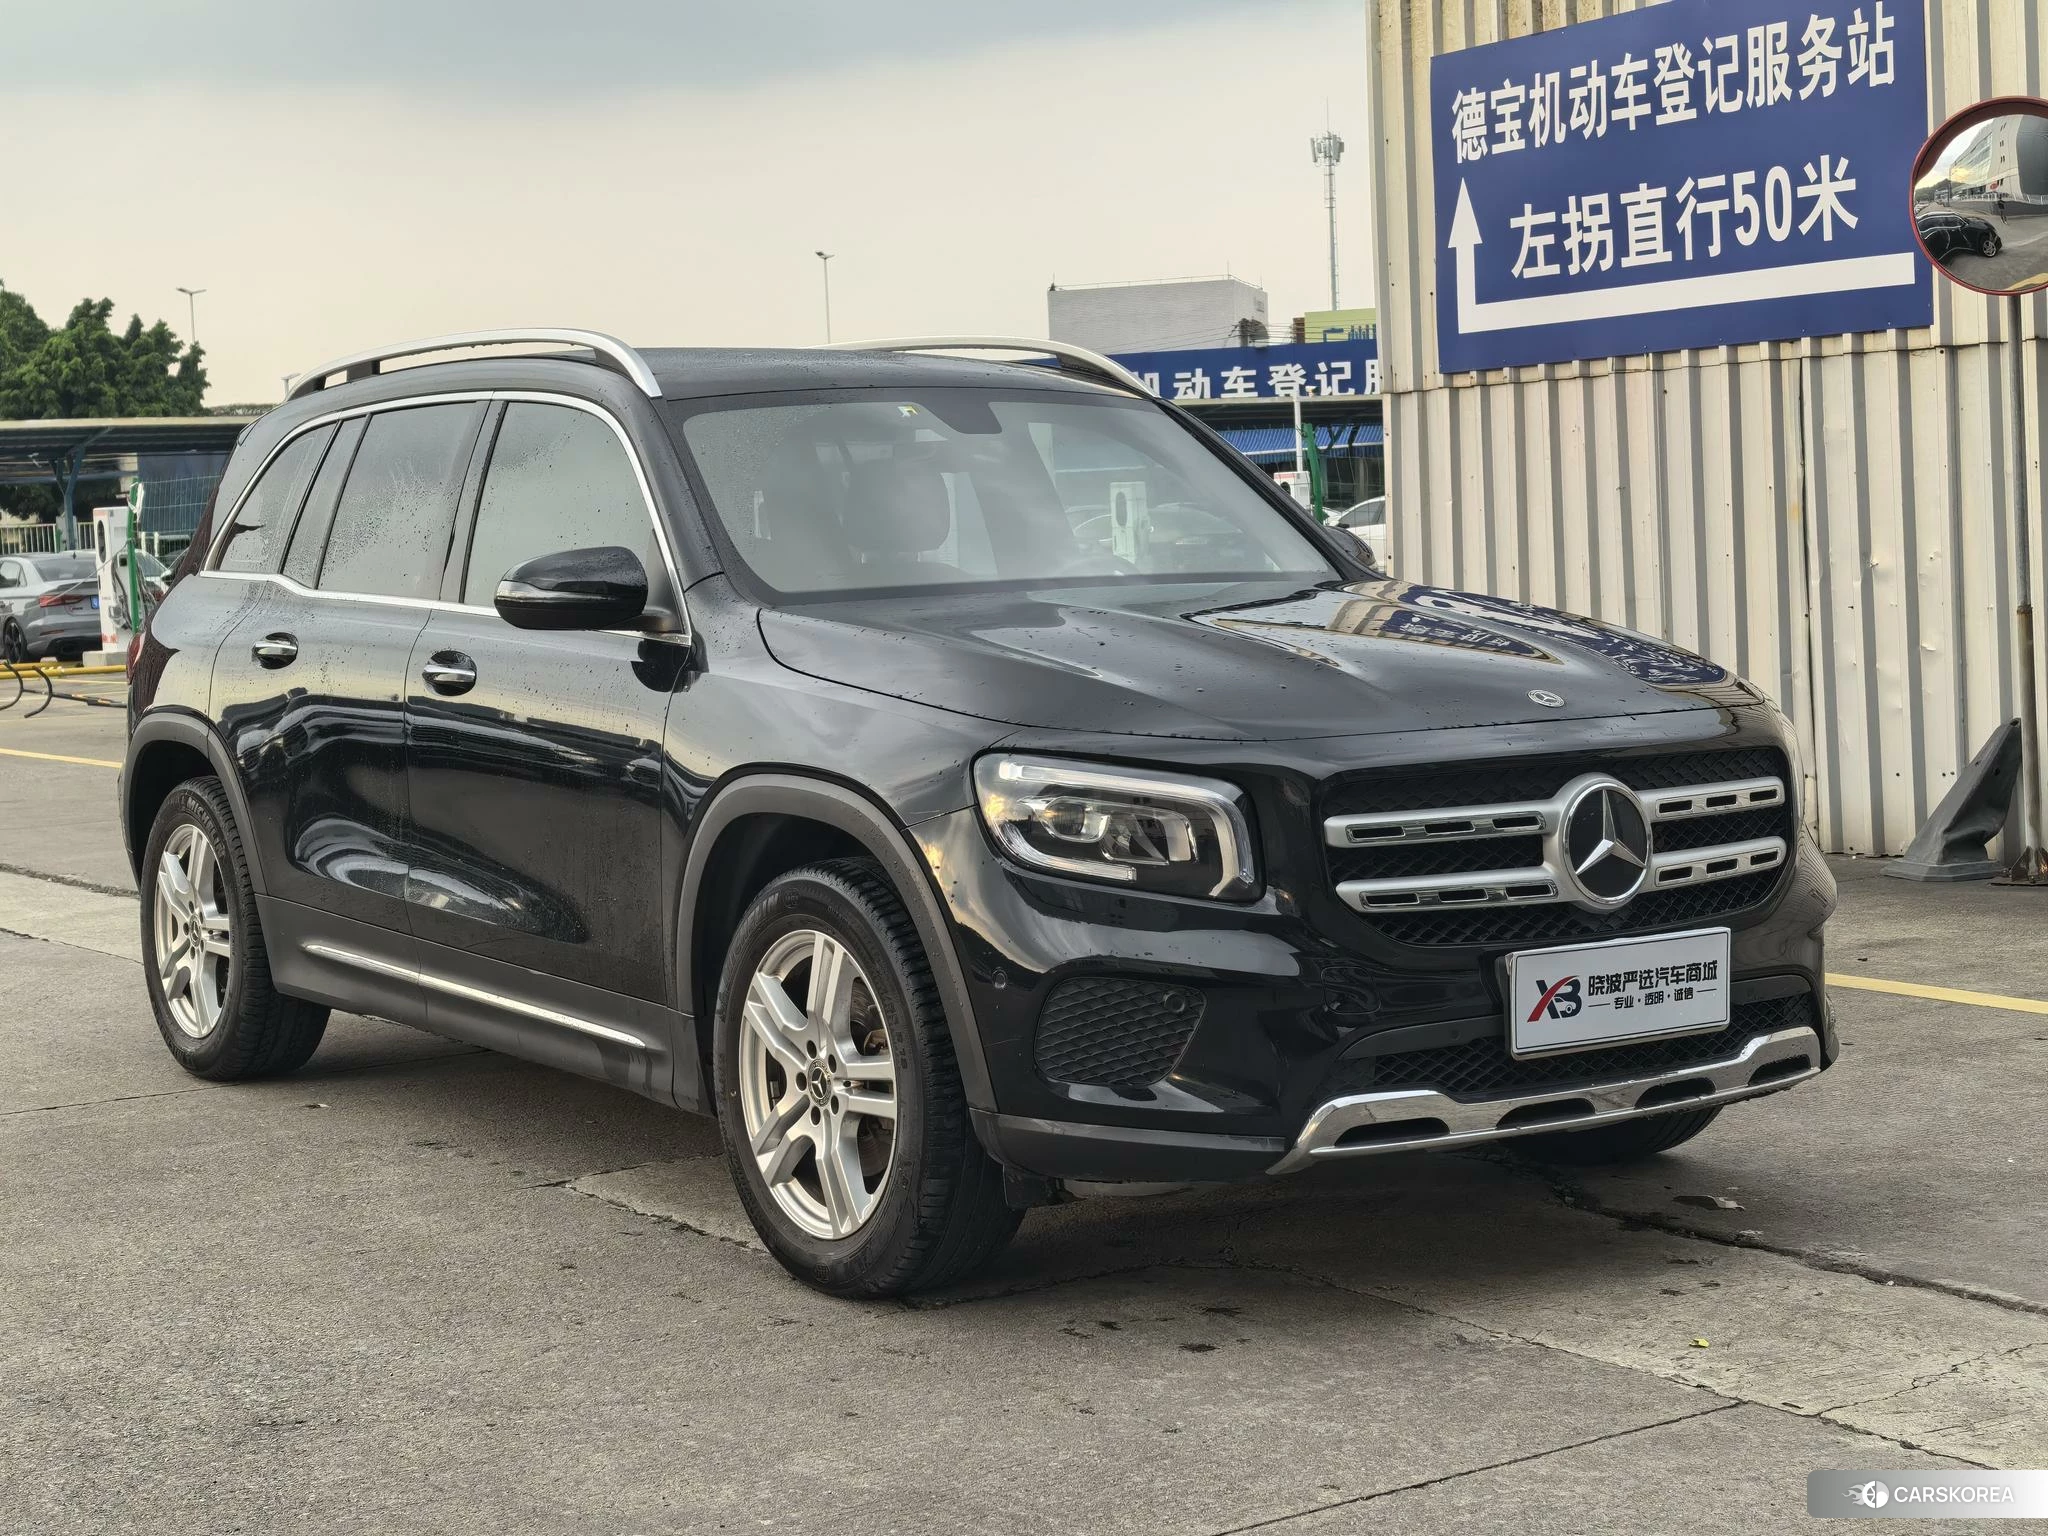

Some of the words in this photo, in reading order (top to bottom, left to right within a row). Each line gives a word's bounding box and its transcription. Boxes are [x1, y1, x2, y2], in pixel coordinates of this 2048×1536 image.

[1451, 1, 1895, 164] 德宝机动车登记服务站
[1509, 154, 1859, 279] 左拐直行50米
[1588, 960, 1718, 997] 晓波严选汽车商城
